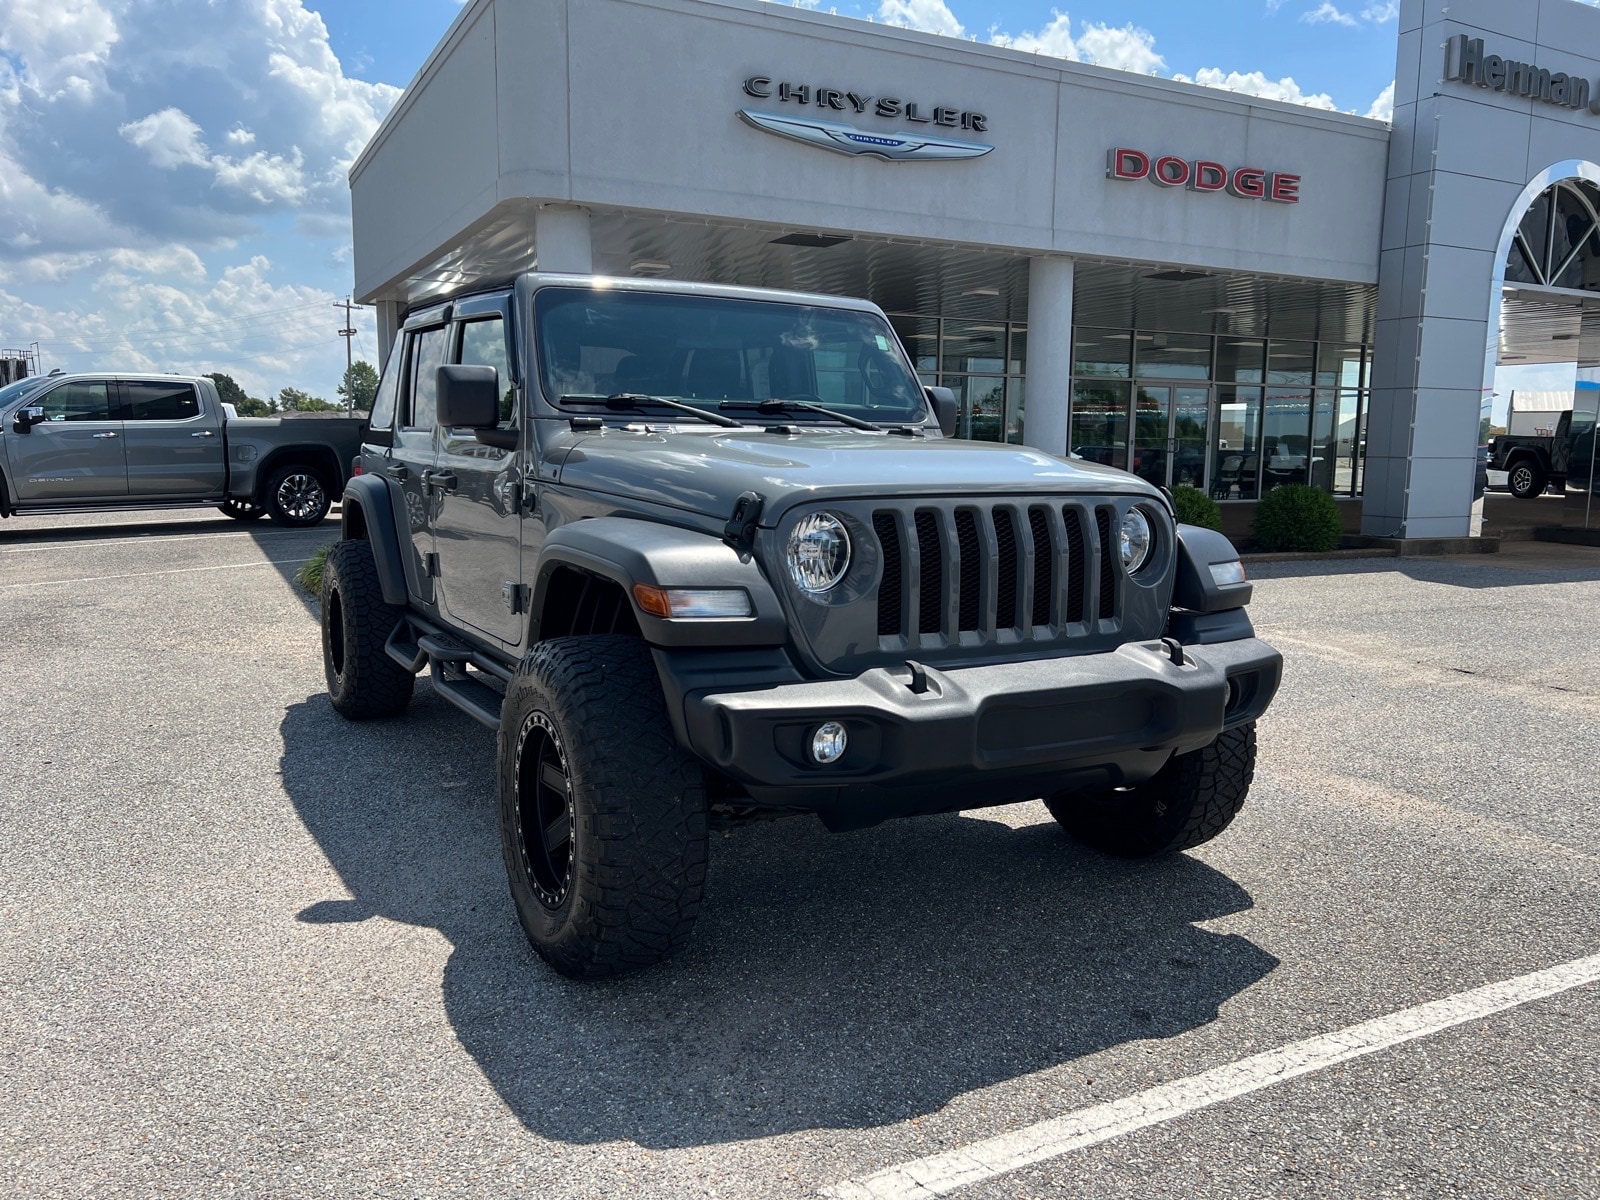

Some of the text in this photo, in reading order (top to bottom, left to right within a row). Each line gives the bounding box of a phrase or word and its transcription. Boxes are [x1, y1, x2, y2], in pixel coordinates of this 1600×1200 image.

[1443, 34, 1590, 110] Herman
[742, 75, 988, 132] CHRYSLER
[849, 134, 899, 146] CHRYSLER
[1106, 147, 1301, 204] DODGE
